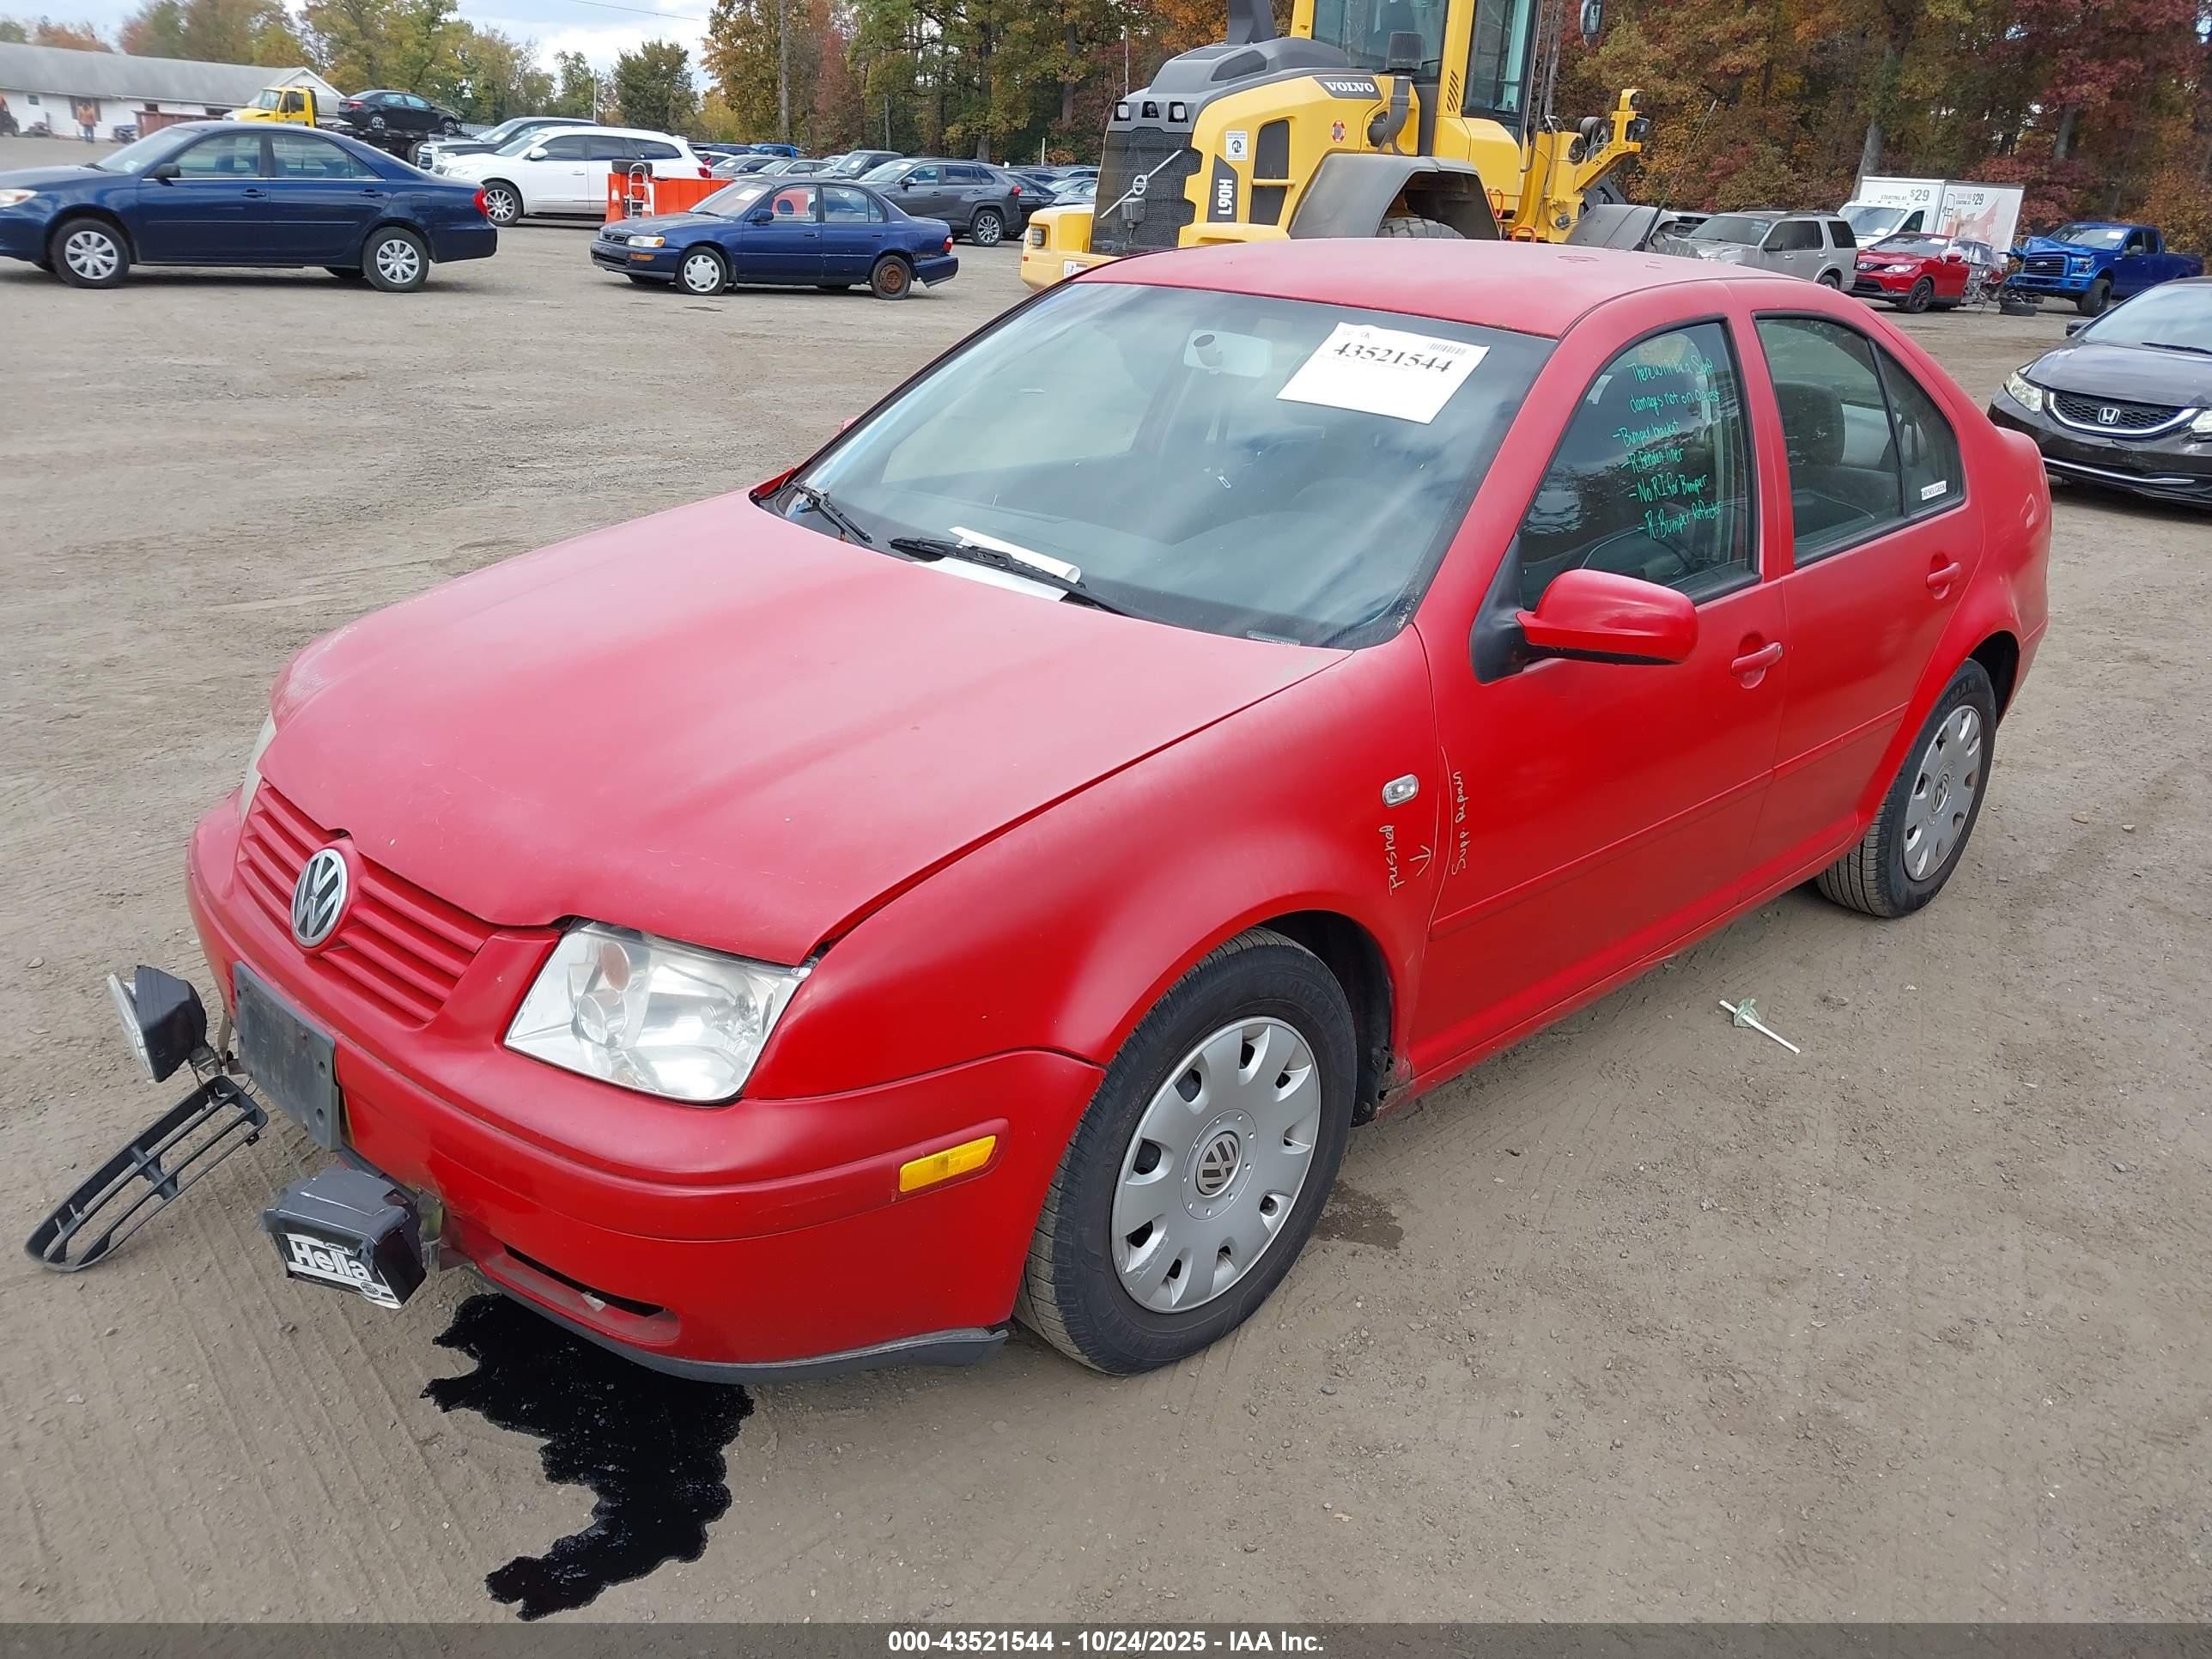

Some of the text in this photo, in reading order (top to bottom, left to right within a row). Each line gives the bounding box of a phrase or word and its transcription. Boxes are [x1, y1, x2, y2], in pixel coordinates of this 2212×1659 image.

[1323, 82, 1375, 93] VOLVO
[1217, 178, 1233, 216] L90H
[1910, 188, 1930, 202] $29
[1972, 192, 1984, 206] $29
[1334, 342, 1453, 373] 43521544
[1626, 362, 1656, 384] There
[1655, 360, 1674, 376] will
[1663, 391, 1680, 405] not
[1681, 392, 1695, 404] on
[1666, 471, 1679, 497] for
[1678, 474, 1708, 495] Bumper
[1657, 508, 1690, 538] Bumper
[289, 1239, 373, 1282] Hella
